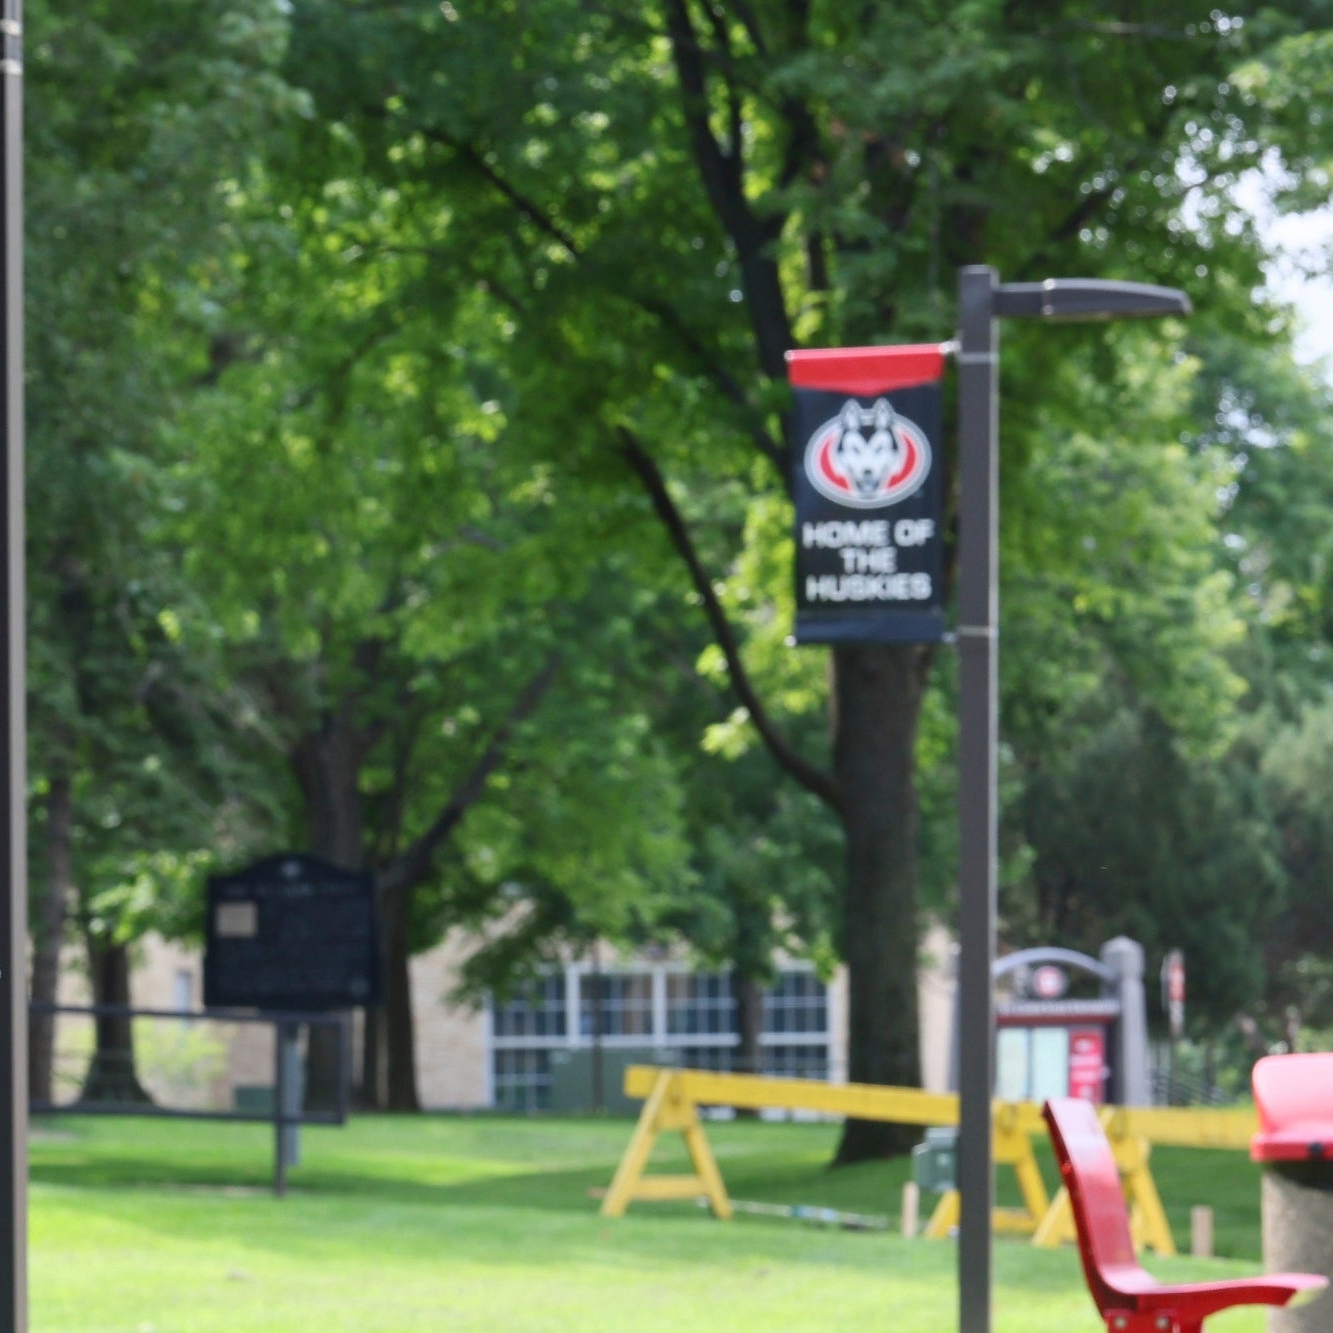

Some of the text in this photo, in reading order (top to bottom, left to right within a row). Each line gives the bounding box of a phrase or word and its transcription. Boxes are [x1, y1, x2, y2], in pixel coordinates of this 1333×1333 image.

[802, 518, 935, 549] HOME OF
[839, 547, 898, 574] THE
[805, 572, 932, 601] HUSKIES
